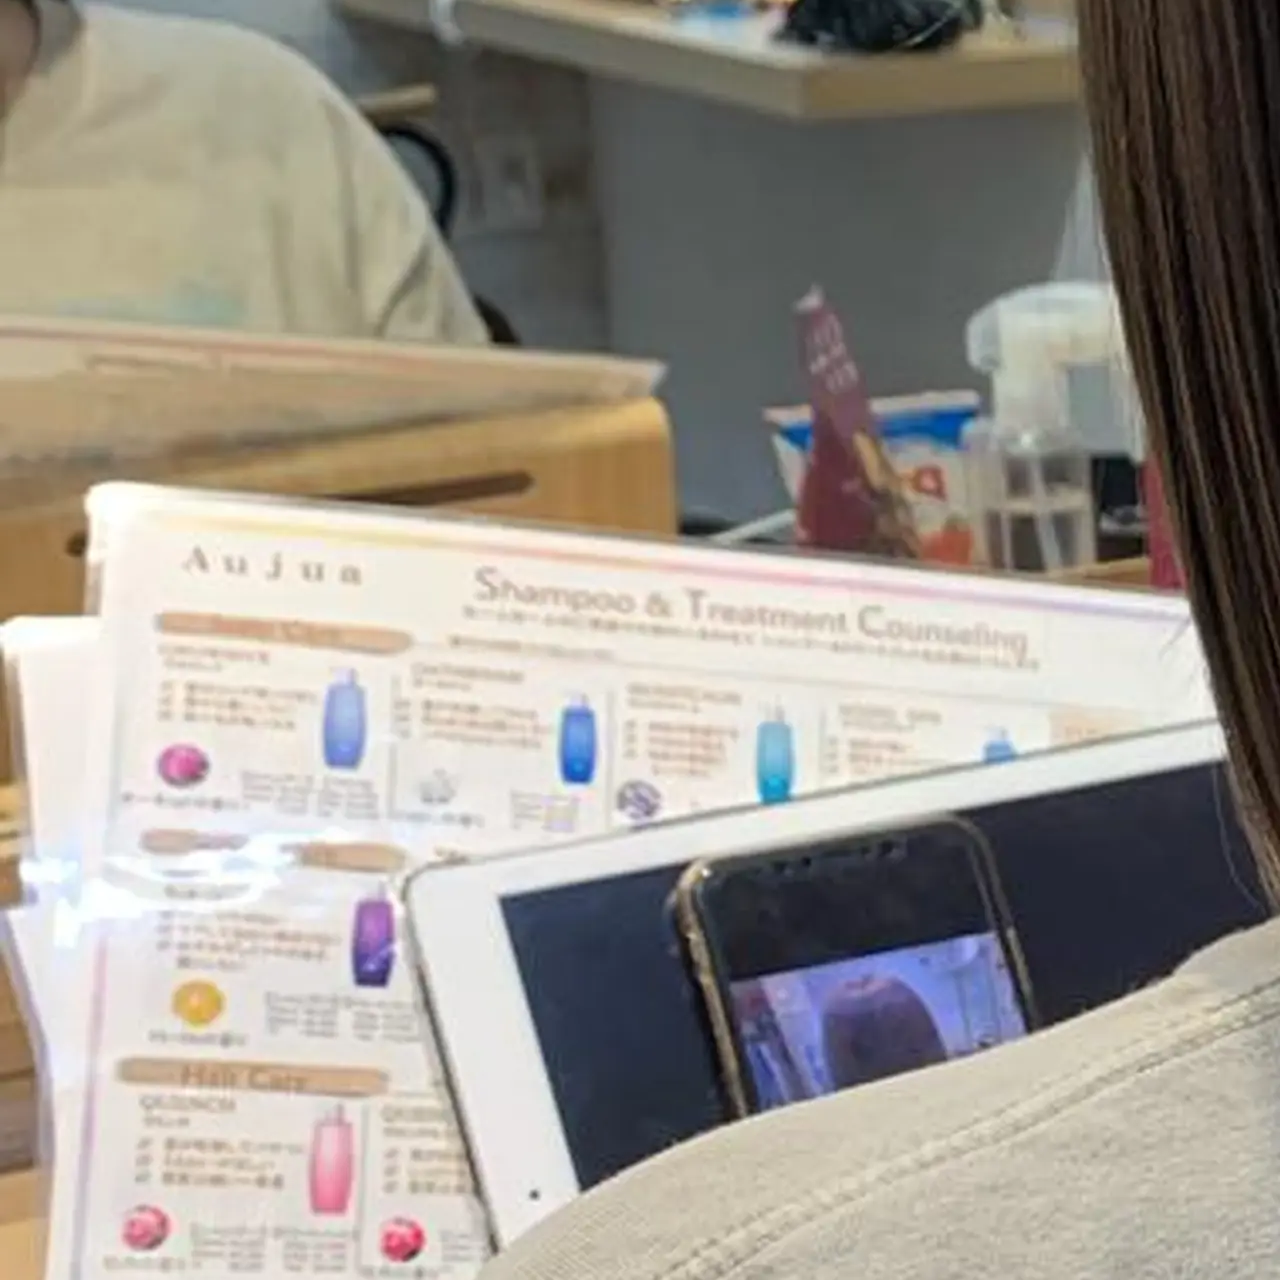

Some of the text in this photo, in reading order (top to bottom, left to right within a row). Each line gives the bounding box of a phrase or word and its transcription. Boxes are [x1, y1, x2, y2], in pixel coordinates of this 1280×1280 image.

[475, 565, 637, 614] Shampoo
[645, 590, 672, 618] &
[682, 587, 849, 634] Treatment
[857, 603, 1029, 662] Counseling
[180, 1064, 309, 1091] Hair Care
